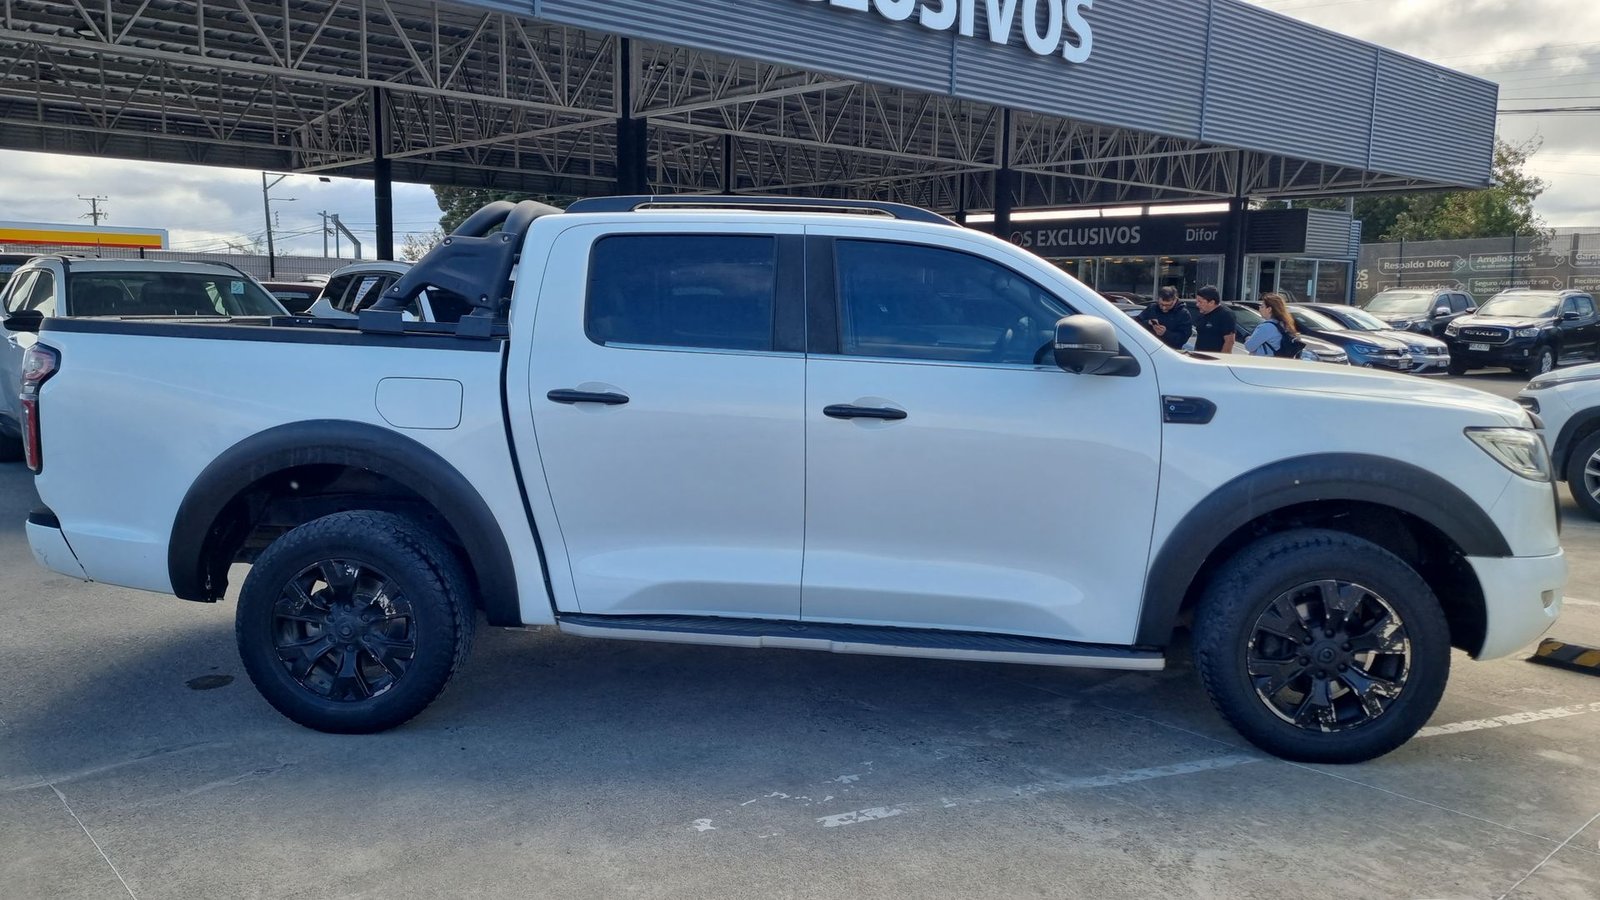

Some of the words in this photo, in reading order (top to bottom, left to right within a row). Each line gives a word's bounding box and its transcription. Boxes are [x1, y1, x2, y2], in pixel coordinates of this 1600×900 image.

[1037, 226, 1141, 247] EXCLUSIVOS
[1186, 228, 1218, 242] Difor
[1384, 260, 1425, 271] Respaldo
[1427, 259, 1451, 268] Difor
[1477, 255, 1507, 264] Amplio
